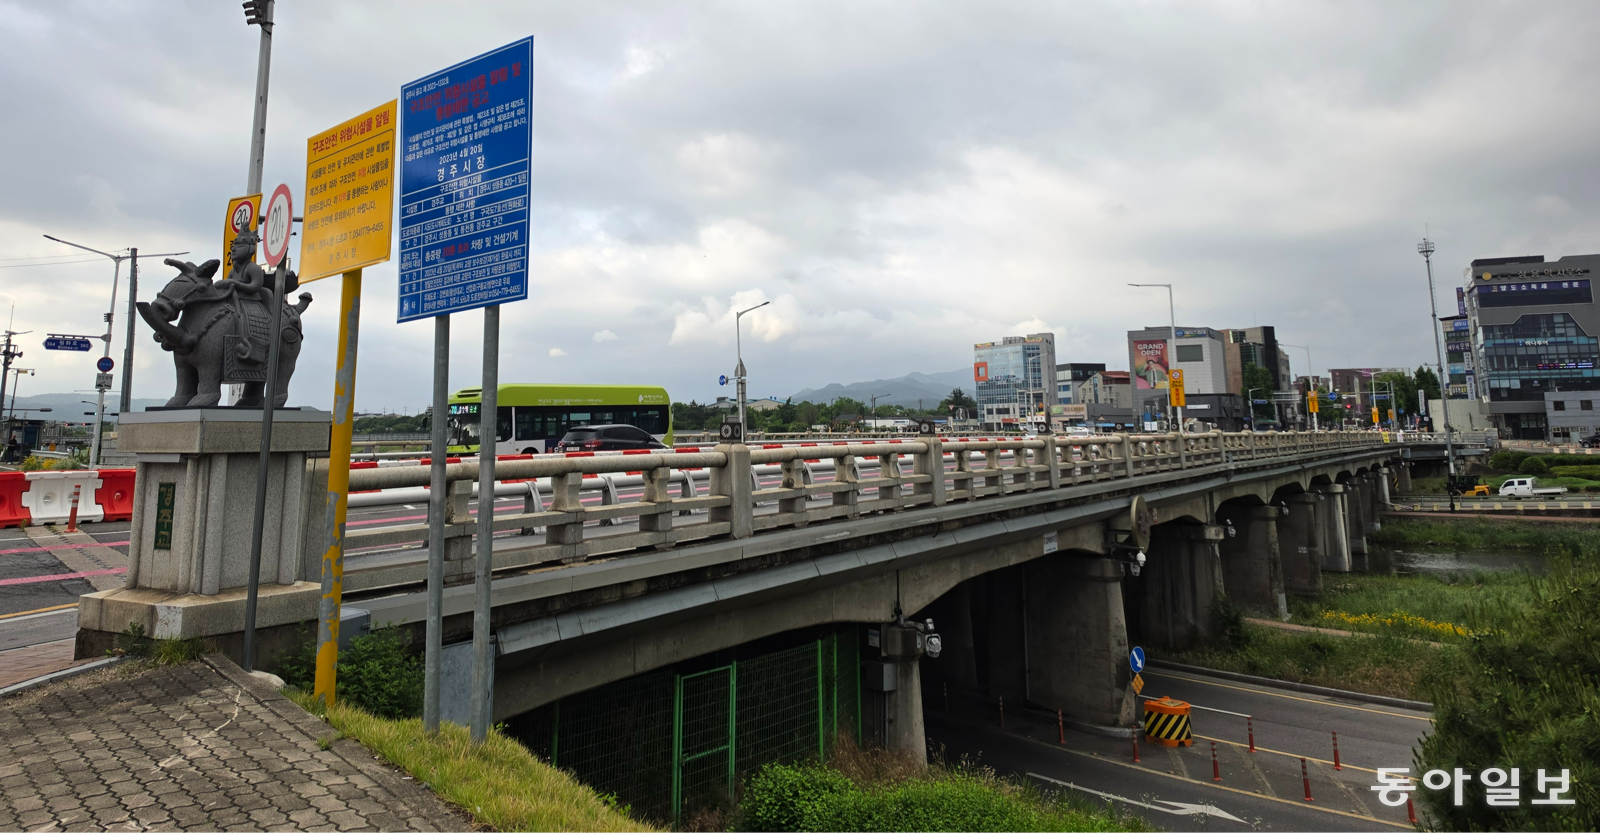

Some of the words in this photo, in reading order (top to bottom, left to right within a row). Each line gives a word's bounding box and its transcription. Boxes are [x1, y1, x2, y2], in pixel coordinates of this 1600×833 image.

[411, 91, 441, 113] 구조안전
[445, 75, 486, 99] 위험시설물
[490, 67, 508, 85] 알림
[512, 61, 521, 77] 및
[436, 97, 469, 121] 통행제한
[472, 91, 489, 108] 공고
[313, 133, 337, 154] 구조안전
[340, 118, 372, 142] 위험시설물
[375, 110, 389, 128] 알림
[311, 167, 326, 179] 시설물의
[328, 162, 336, 174] 안전
[337, 160, 341, 169] 및
[343, 151, 364, 166] 유지관리에
[366, 146, 374, 158] 관한
[376, 141, 389, 153] 특별법
[439, 152, 457, 165] 2023년
[459, 148, 468, 157] 4월
[470, 144, 482, 155] 20일
[329, 179, 337, 189] 따라
[340, 171, 356, 185] 구조안전
[352, 185, 369, 199] 통행하는
[370, 177, 388, 191] 사람이나
[439, 181, 458, 194] 구조안전
[459, 174, 483, 187] 위험시설물
[406, 205, 417, 214] 시설명
[432, 197, 444, 207] 경주교
[480, 183, 492, 194] 경주시
[444, 205, 455, 216] 통행
[455, 202, 465, 213] 제한
[465, 200, 476, 210] 사항
[270, 205, 284, 245] 20t
[334, 207, 355, 223] 유의하시기
[424, 233, 438, 243] 경주시
[493, 216, 503, 225] 구간
[425, 249, 441, 262] 총중량
[471, 238, 483, 250] 차량
[485, 236, 491, 247] 및
[494, 230, 518, 245] 건설기계
